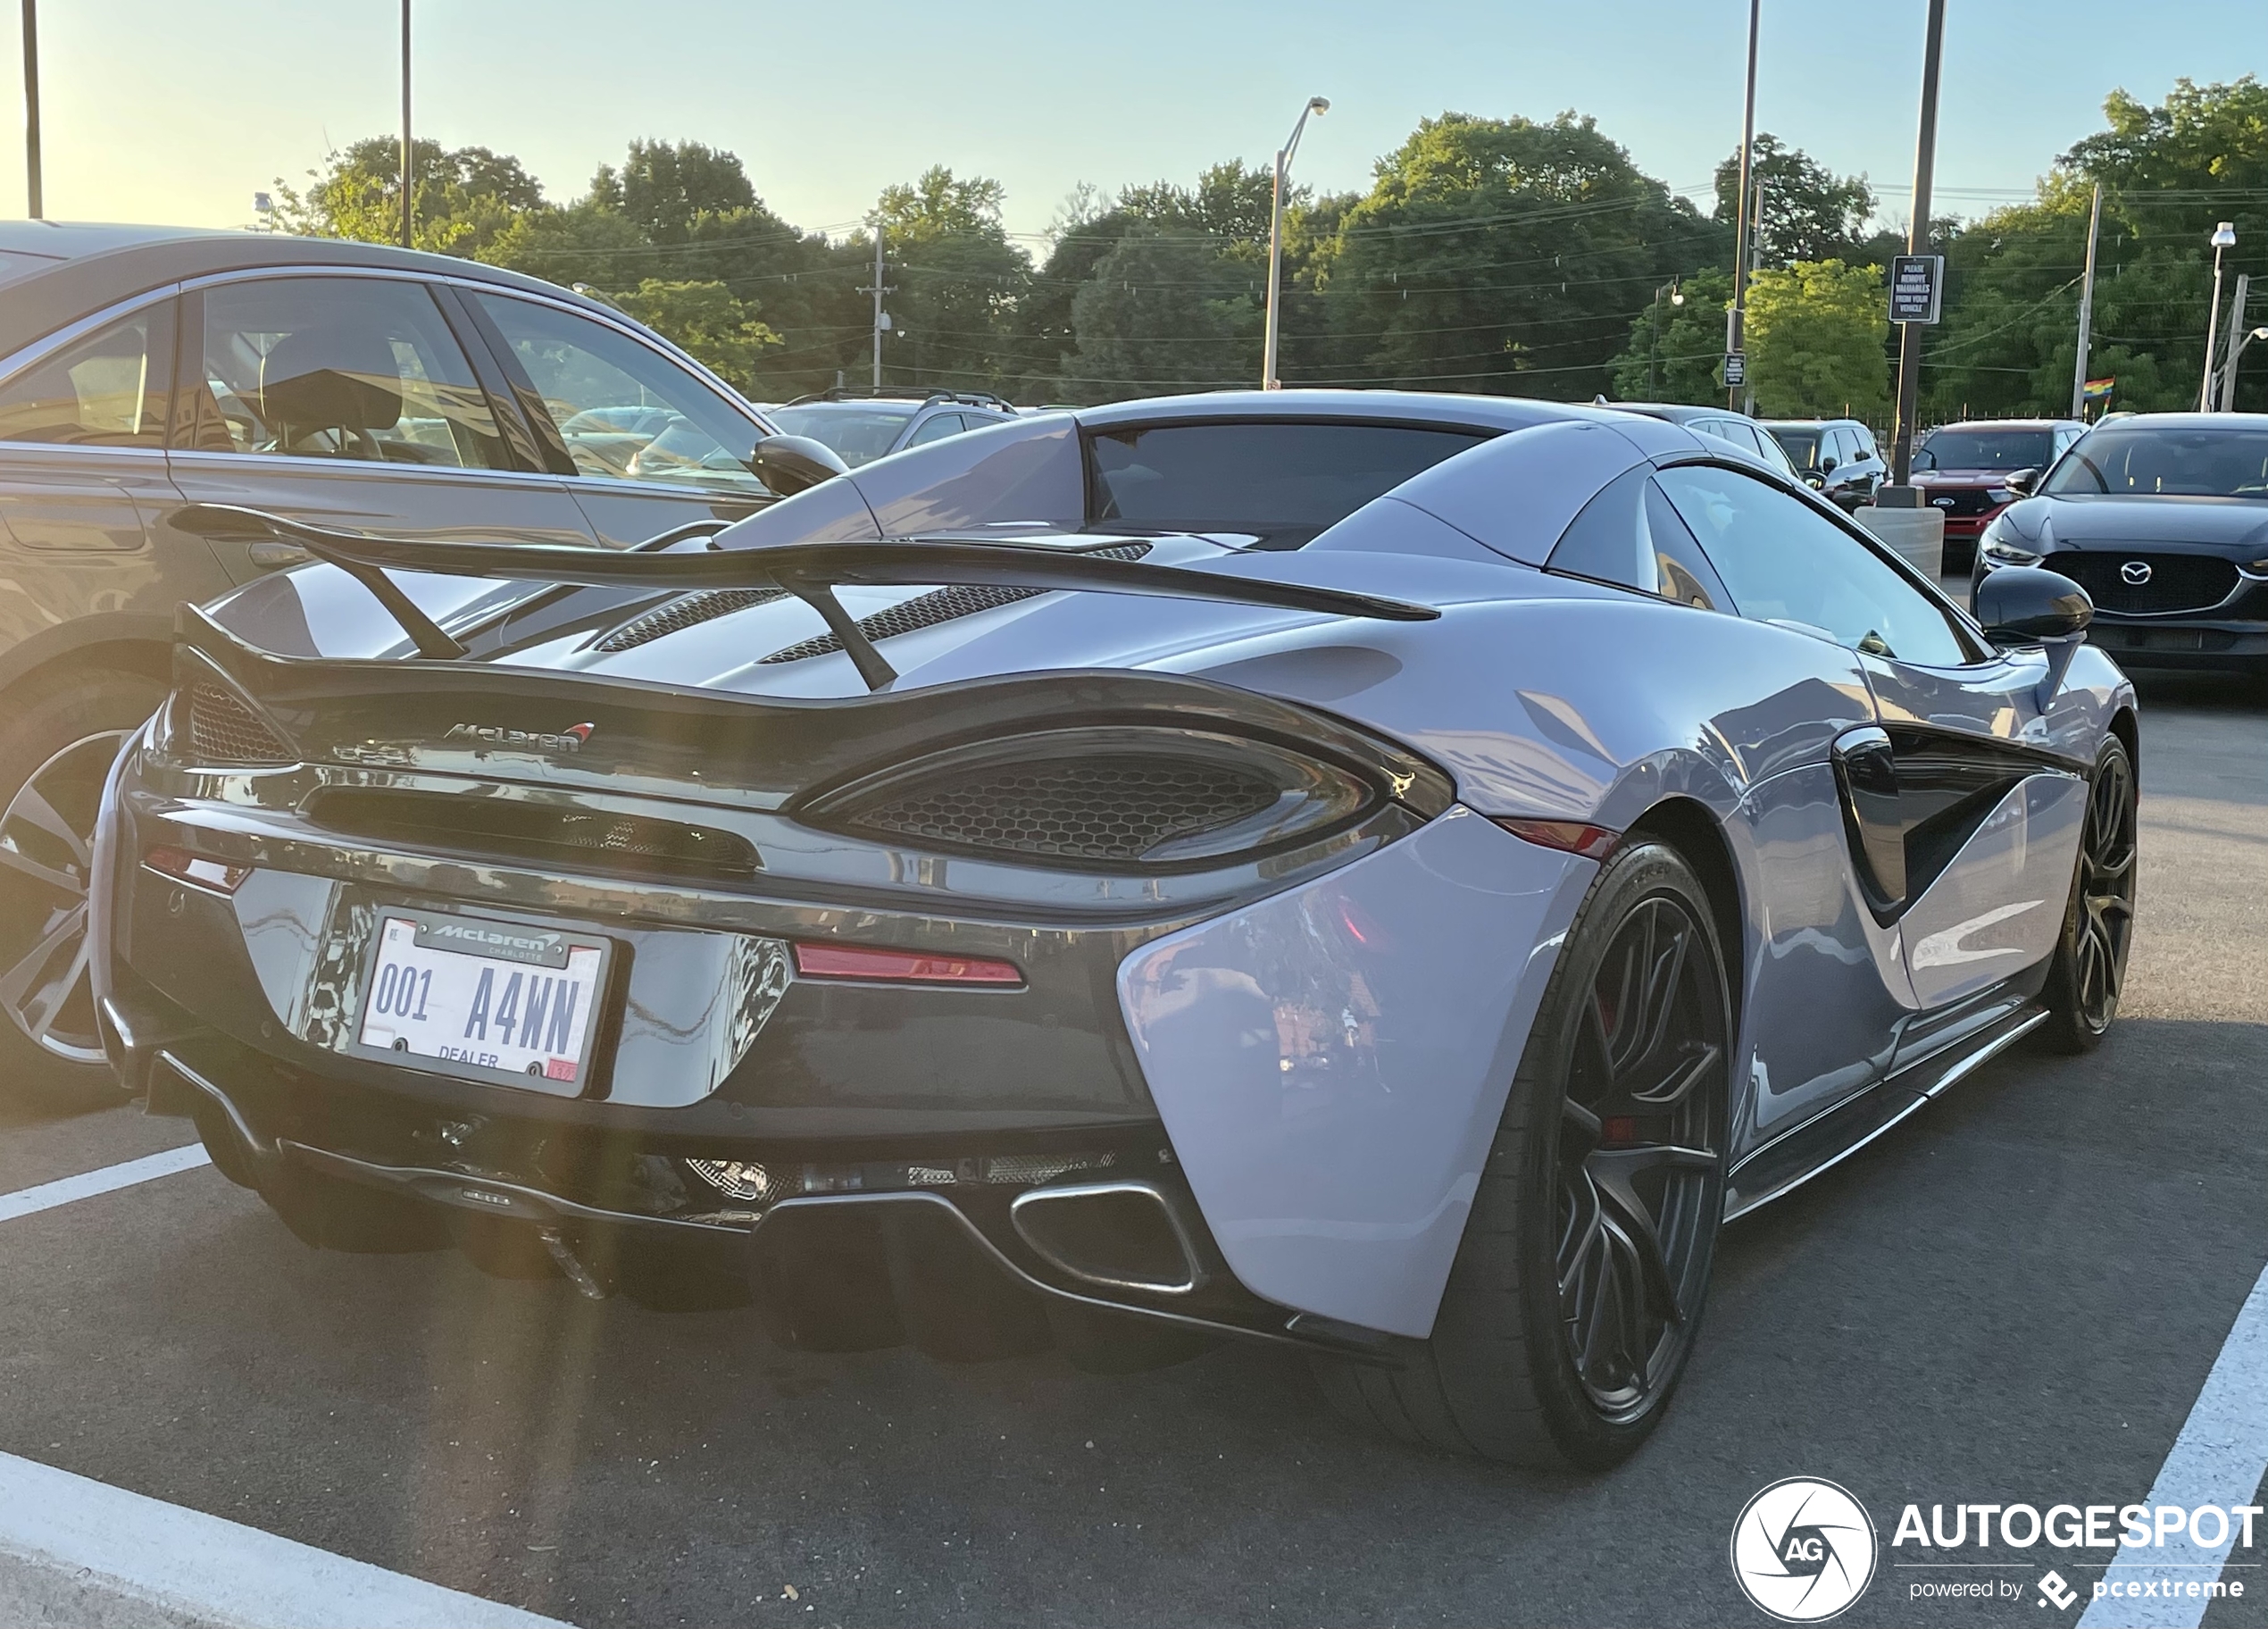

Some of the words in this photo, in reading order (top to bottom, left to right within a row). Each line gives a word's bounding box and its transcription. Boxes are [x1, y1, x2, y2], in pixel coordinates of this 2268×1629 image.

[1905, 264, 1924, 273] PLEASE
[1901, 274, 1926, 283] REMOVE
[1896, 284, 1930, 293] VALUABLES
[1895, 295, 1912, 303] FROM
[1914, 295, 1928, 303] YOUR
[1900, 305, 1922, 313] VEHICLE
[444, 722, 580, 753] McLaren
[433, 924, 545, 952] McLaren
[376, 963, 433, 1022] 001
[463, 967, 580, 1055] A4WN
[438, 1045, 499, 1068] DEALER
